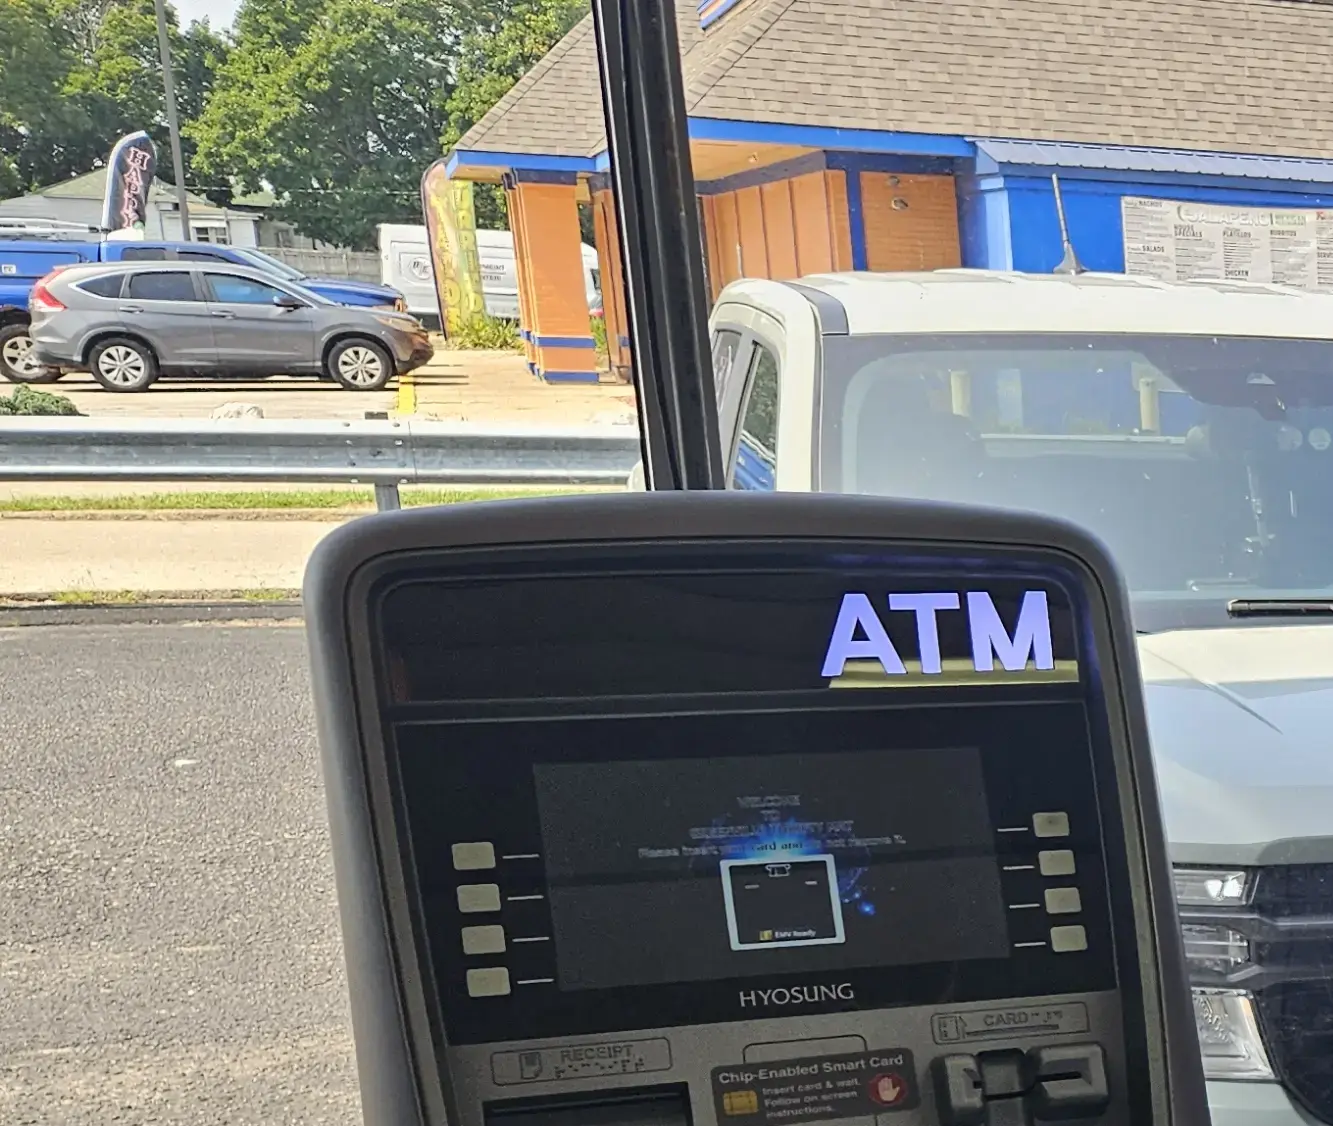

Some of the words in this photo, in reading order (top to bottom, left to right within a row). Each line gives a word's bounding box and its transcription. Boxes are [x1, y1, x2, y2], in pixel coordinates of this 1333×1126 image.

[821, 591, 1054, 677] ATM
[738, 983, 855, 1008] HYOSUNG
[983, 1013, 1028, 1027] CARD
[560, 1043, 634, 1062] RECEIPT
[719, 1064, 818, 1084] Chip-Enabled
[823, 1059, 865, 1073] Smart
[869, 1055, 904, 1067] Card
[798, 1082, 823, 1092] card
